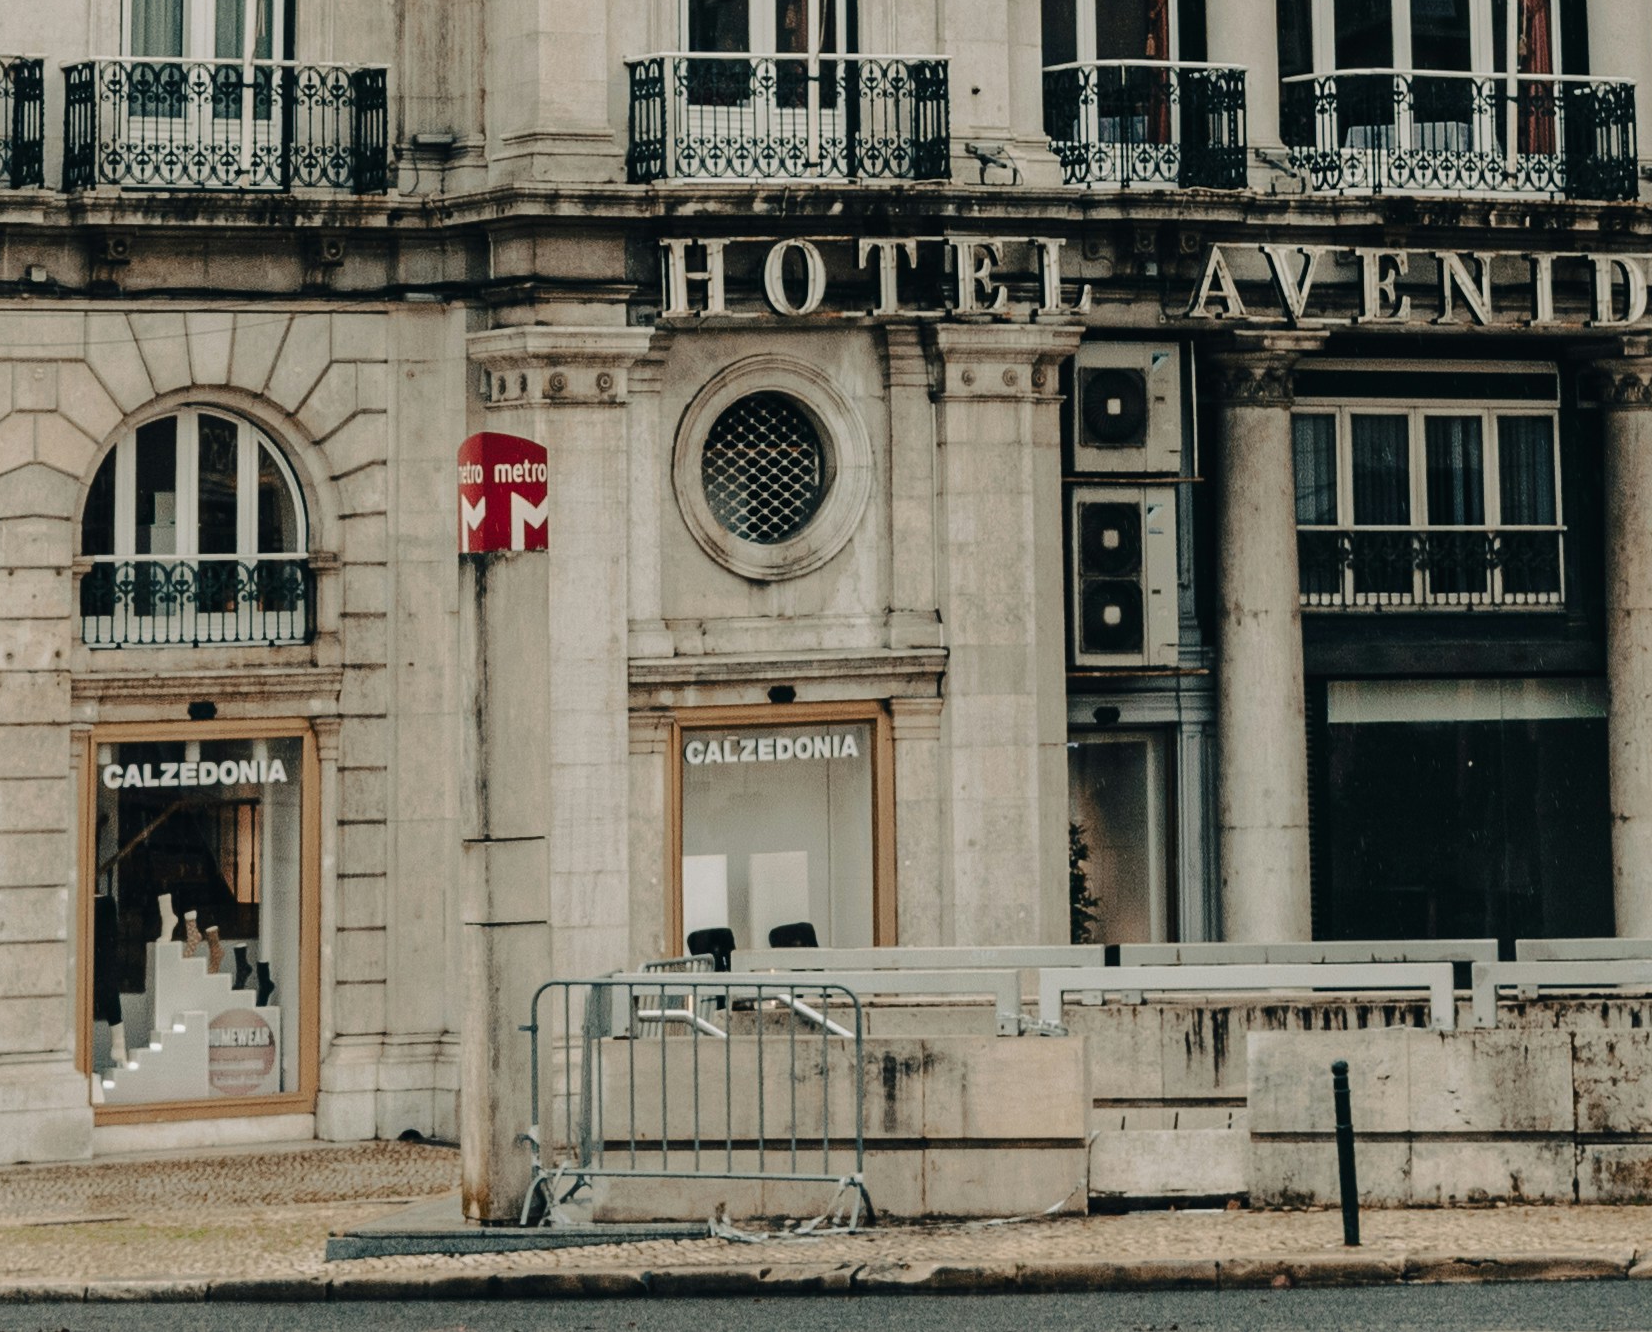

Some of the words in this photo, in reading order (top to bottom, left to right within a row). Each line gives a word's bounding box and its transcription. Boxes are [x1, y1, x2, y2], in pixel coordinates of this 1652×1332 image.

[659, 237, 1092, 318] HOTEL
[494, 459, 547, 484] metro
[685, 734, 860, 765] CALZEDONIA
[103, 758, 288, 789] CALZEDONIA
